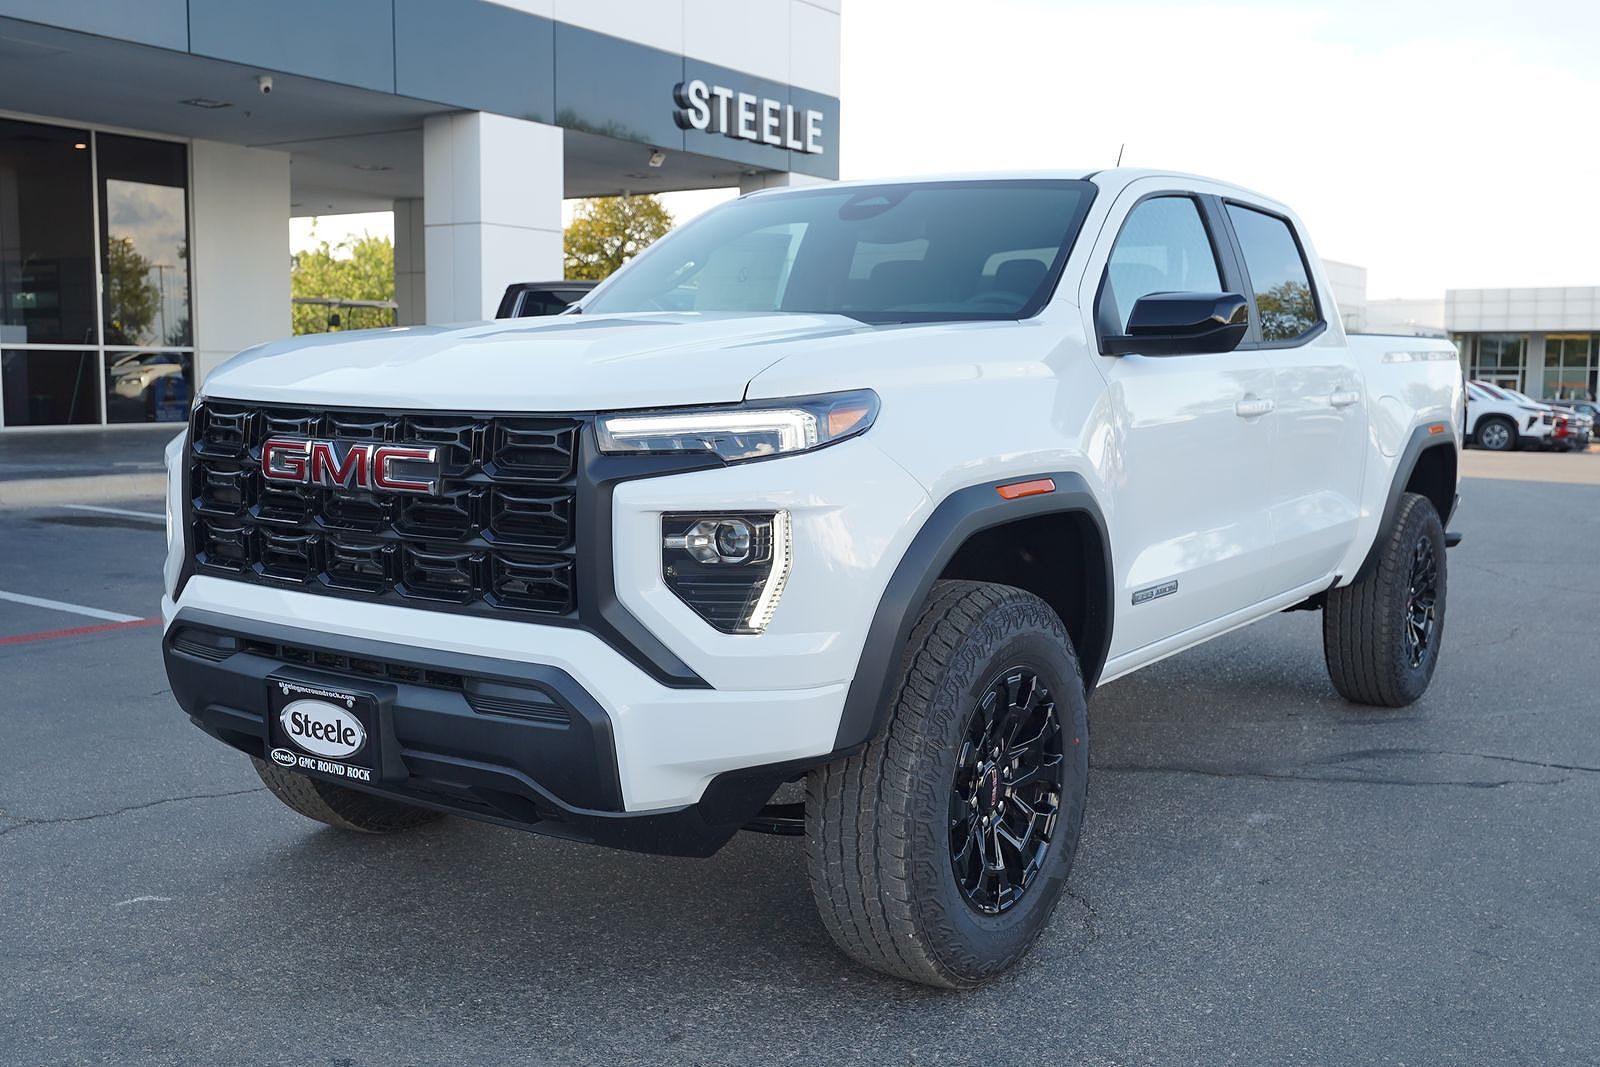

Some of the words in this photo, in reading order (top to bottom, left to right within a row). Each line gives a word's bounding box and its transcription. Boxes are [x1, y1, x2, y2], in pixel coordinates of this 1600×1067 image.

[686, 79, 824, 155] STEELE
[262, 437, 437, 496] GMC
[291, 711, 356, 747] Steele
[274, 750, 294, 763] Steele
[298, 756, 316, 770] GMC
[317, 760, 345, 776] ROUND
[346, 766, 371, 781] ROCK
